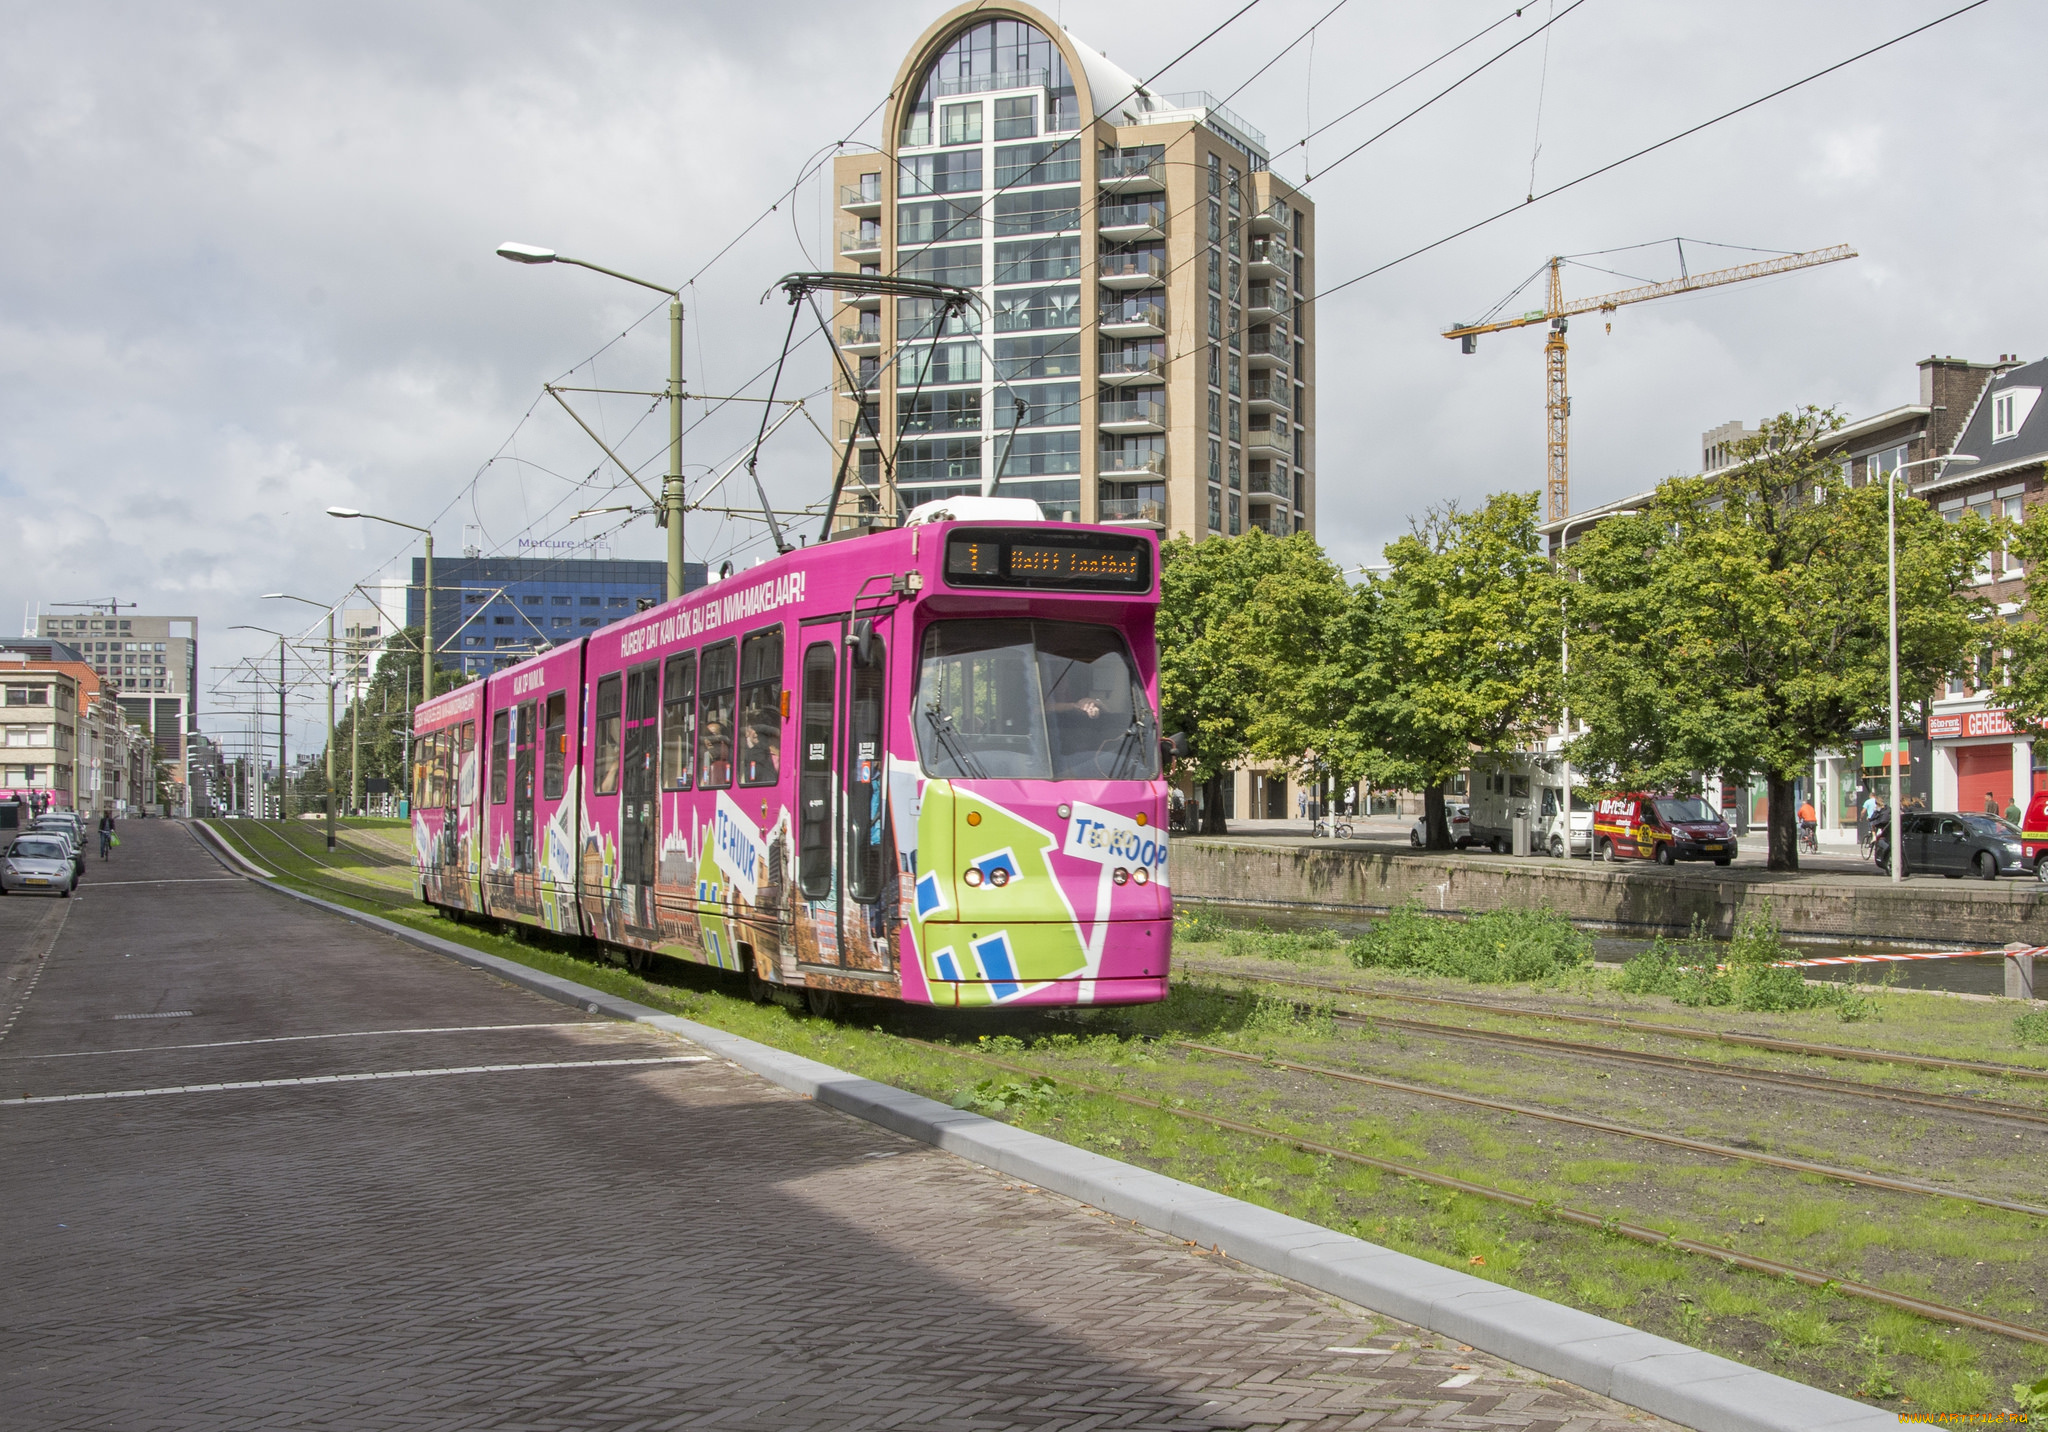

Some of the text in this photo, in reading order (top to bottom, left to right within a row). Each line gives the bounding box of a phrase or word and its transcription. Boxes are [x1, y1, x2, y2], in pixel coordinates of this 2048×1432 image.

[518, 538, 575, 548] Mercure
[969, 543, 978, 571] 1
[620, 627, 646, 658] HUREN?
[646, 622, 660, 650] DAT
[660, 616, 676, 646] KAN
[692, 605, 705, 635] BIJ
[705, 599, 722, 630] EEN
[718, 809, 756, 885] TE HUUR
[1087, 829, 1135, 848] 3060
